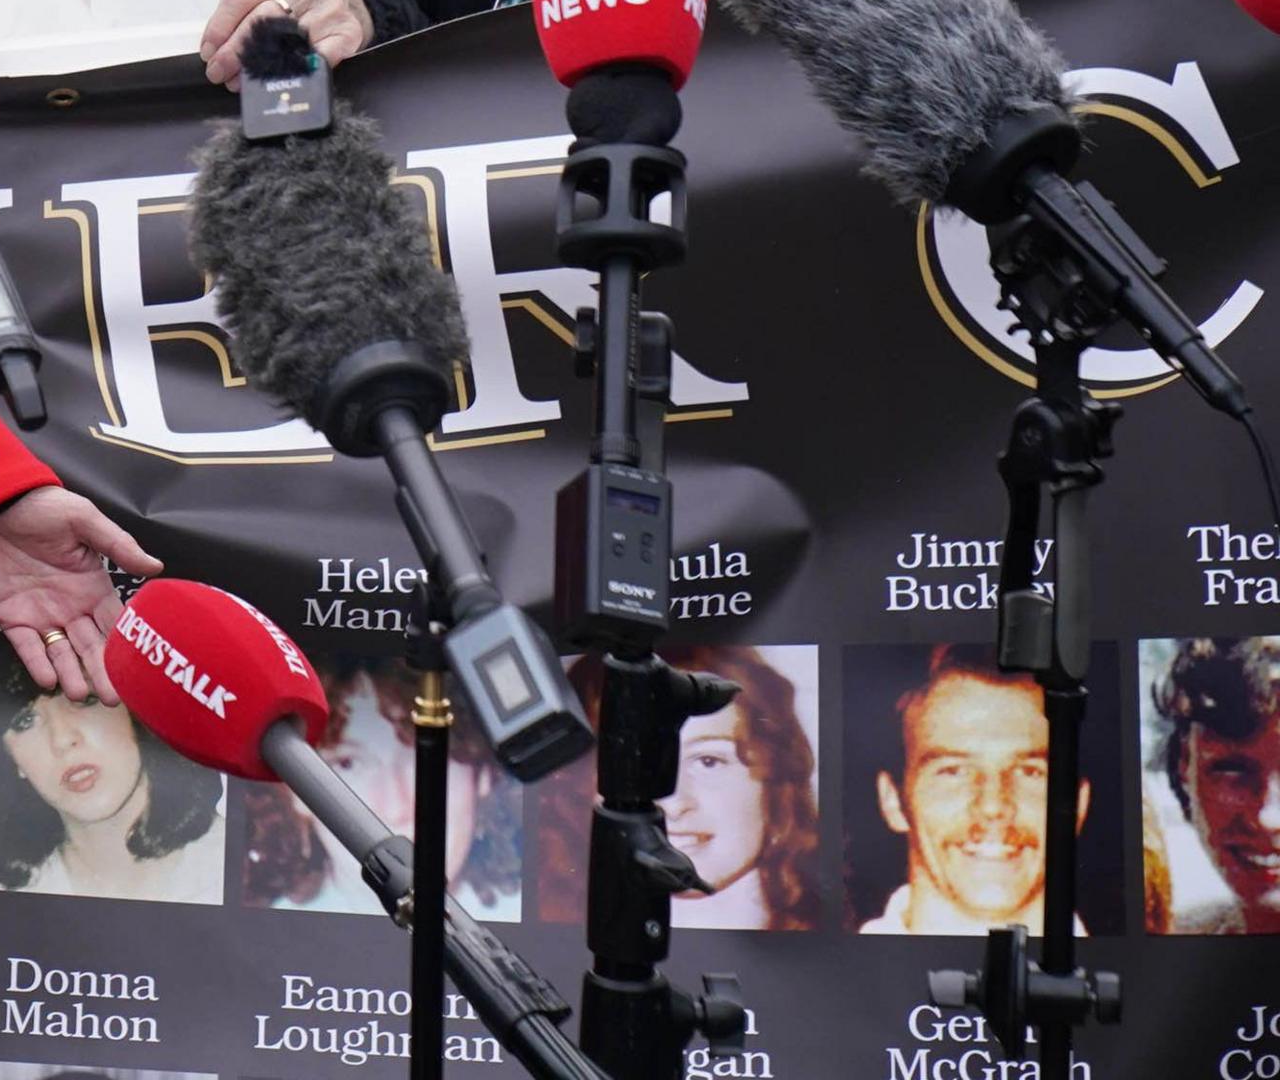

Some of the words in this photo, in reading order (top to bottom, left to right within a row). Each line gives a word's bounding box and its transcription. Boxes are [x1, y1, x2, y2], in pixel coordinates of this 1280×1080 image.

[607, 580, 657, 600] SONY
[7, 956, 159, 1002] Donna
[281, 974, 478, 1021] Eamon
[1, 1000, 160, 1044] Mahon
[885, 1048, 1092, 1080] McGrah
